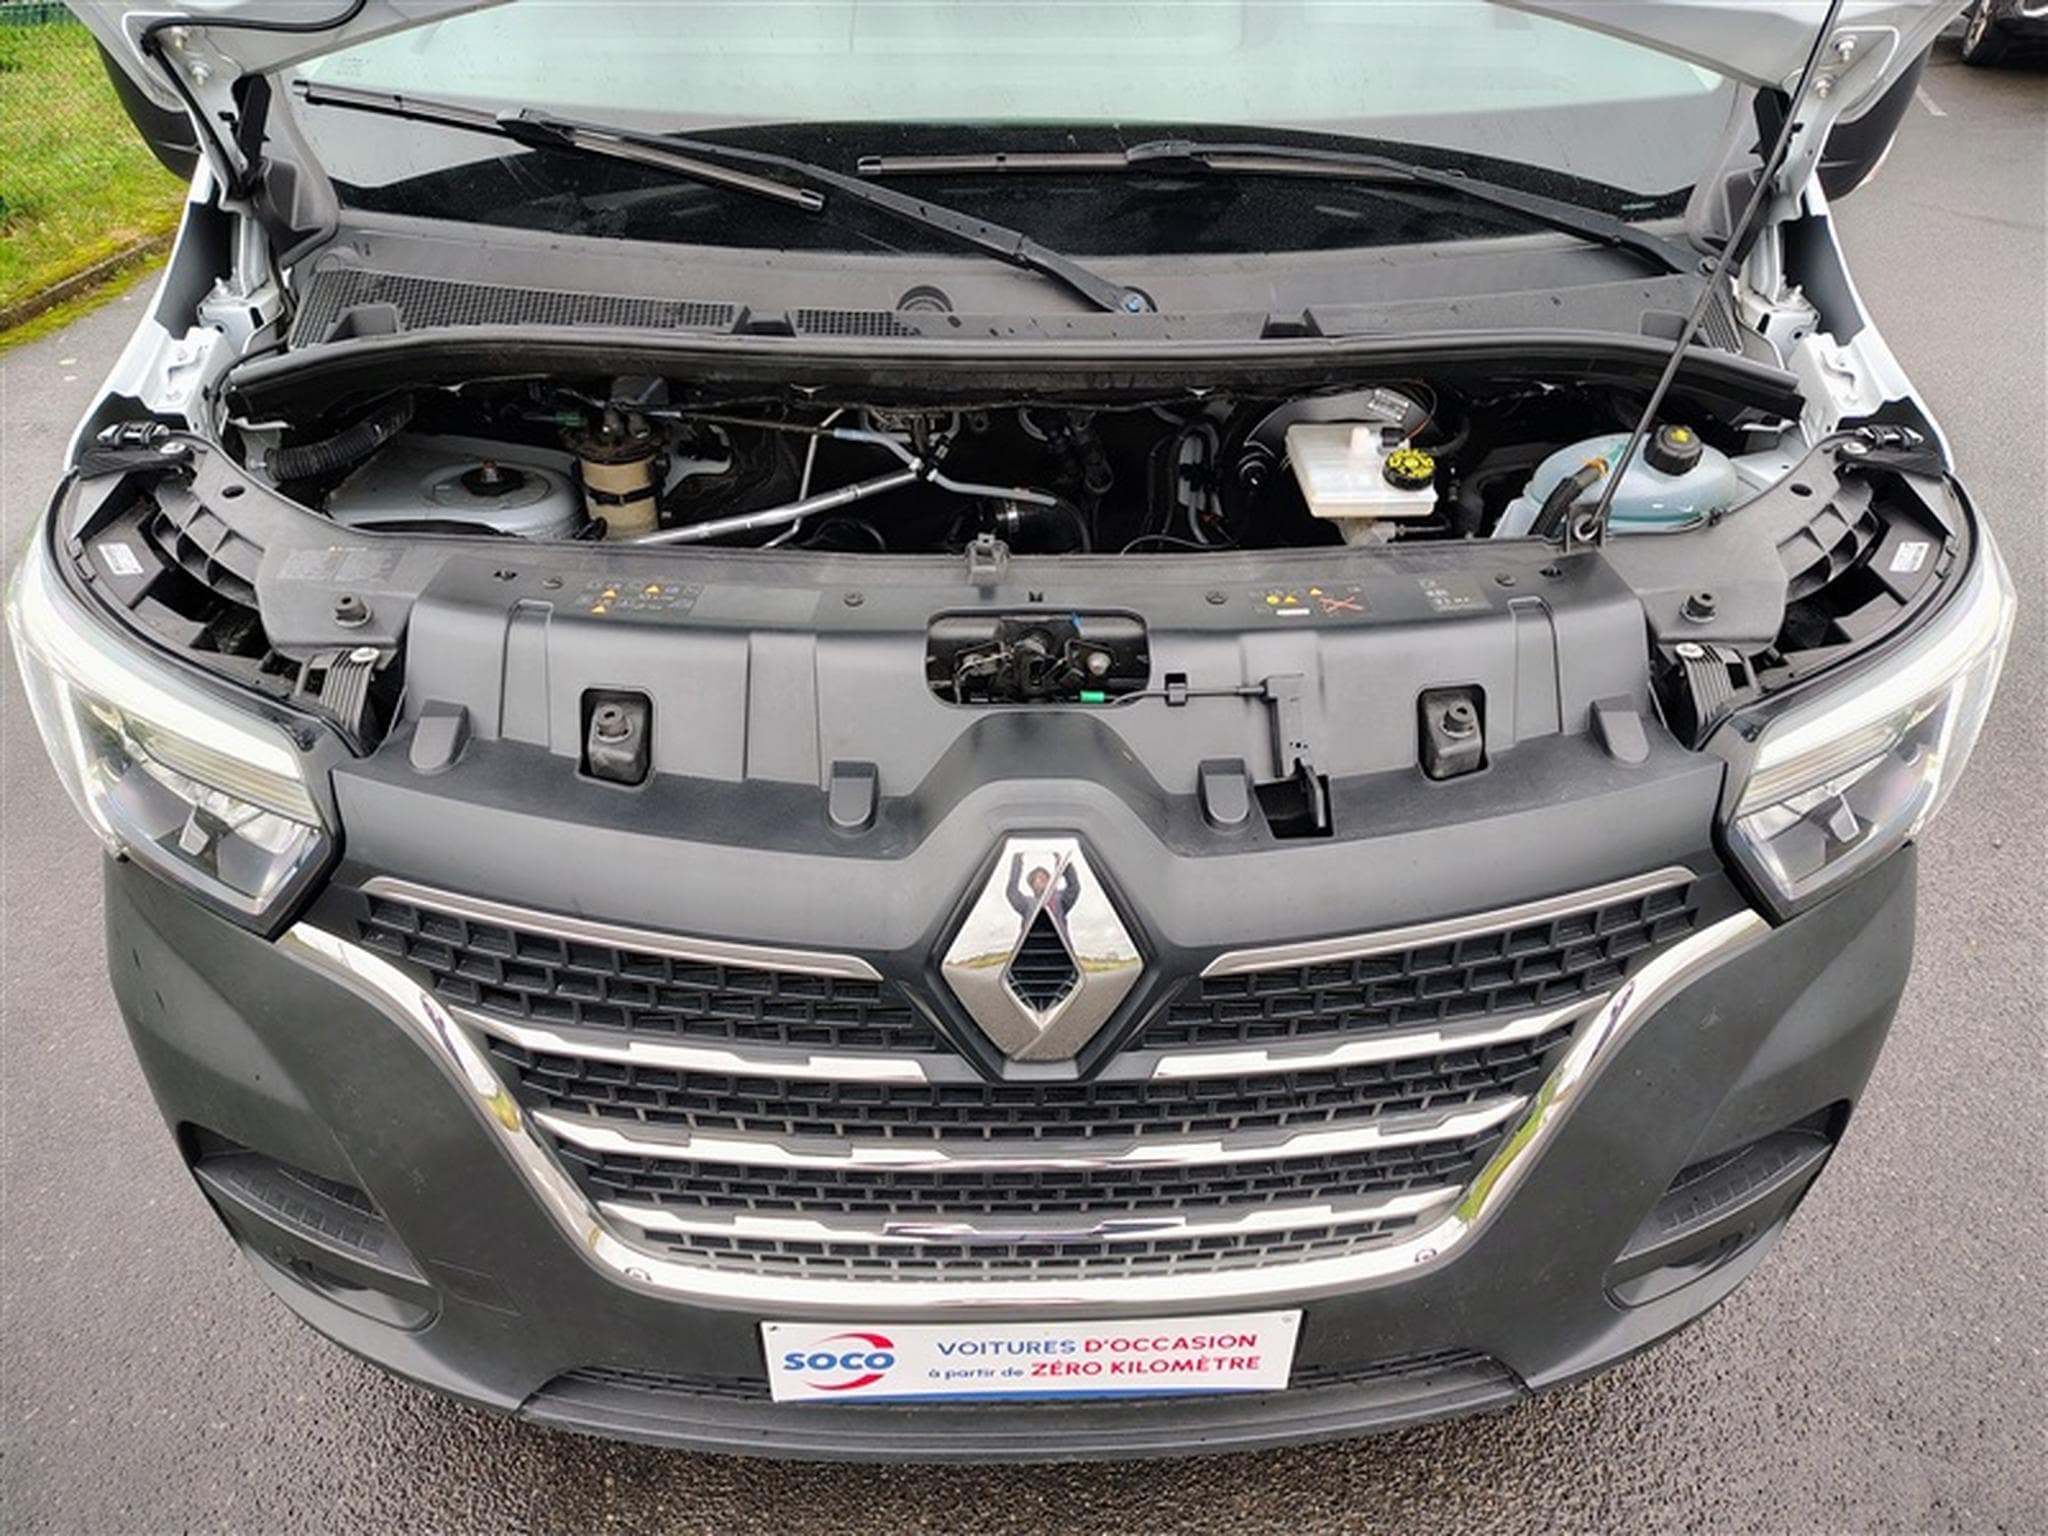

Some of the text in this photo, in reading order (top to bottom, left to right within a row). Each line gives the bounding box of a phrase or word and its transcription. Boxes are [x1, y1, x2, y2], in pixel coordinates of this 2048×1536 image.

[937, 1333, 1258, 1356] VOITURES D'OCCASION
[783, 1352, 895, 1371] SOCO
[928, 1355, 1262, 1380] à partir de ZÉRO KILOMÈTRE
